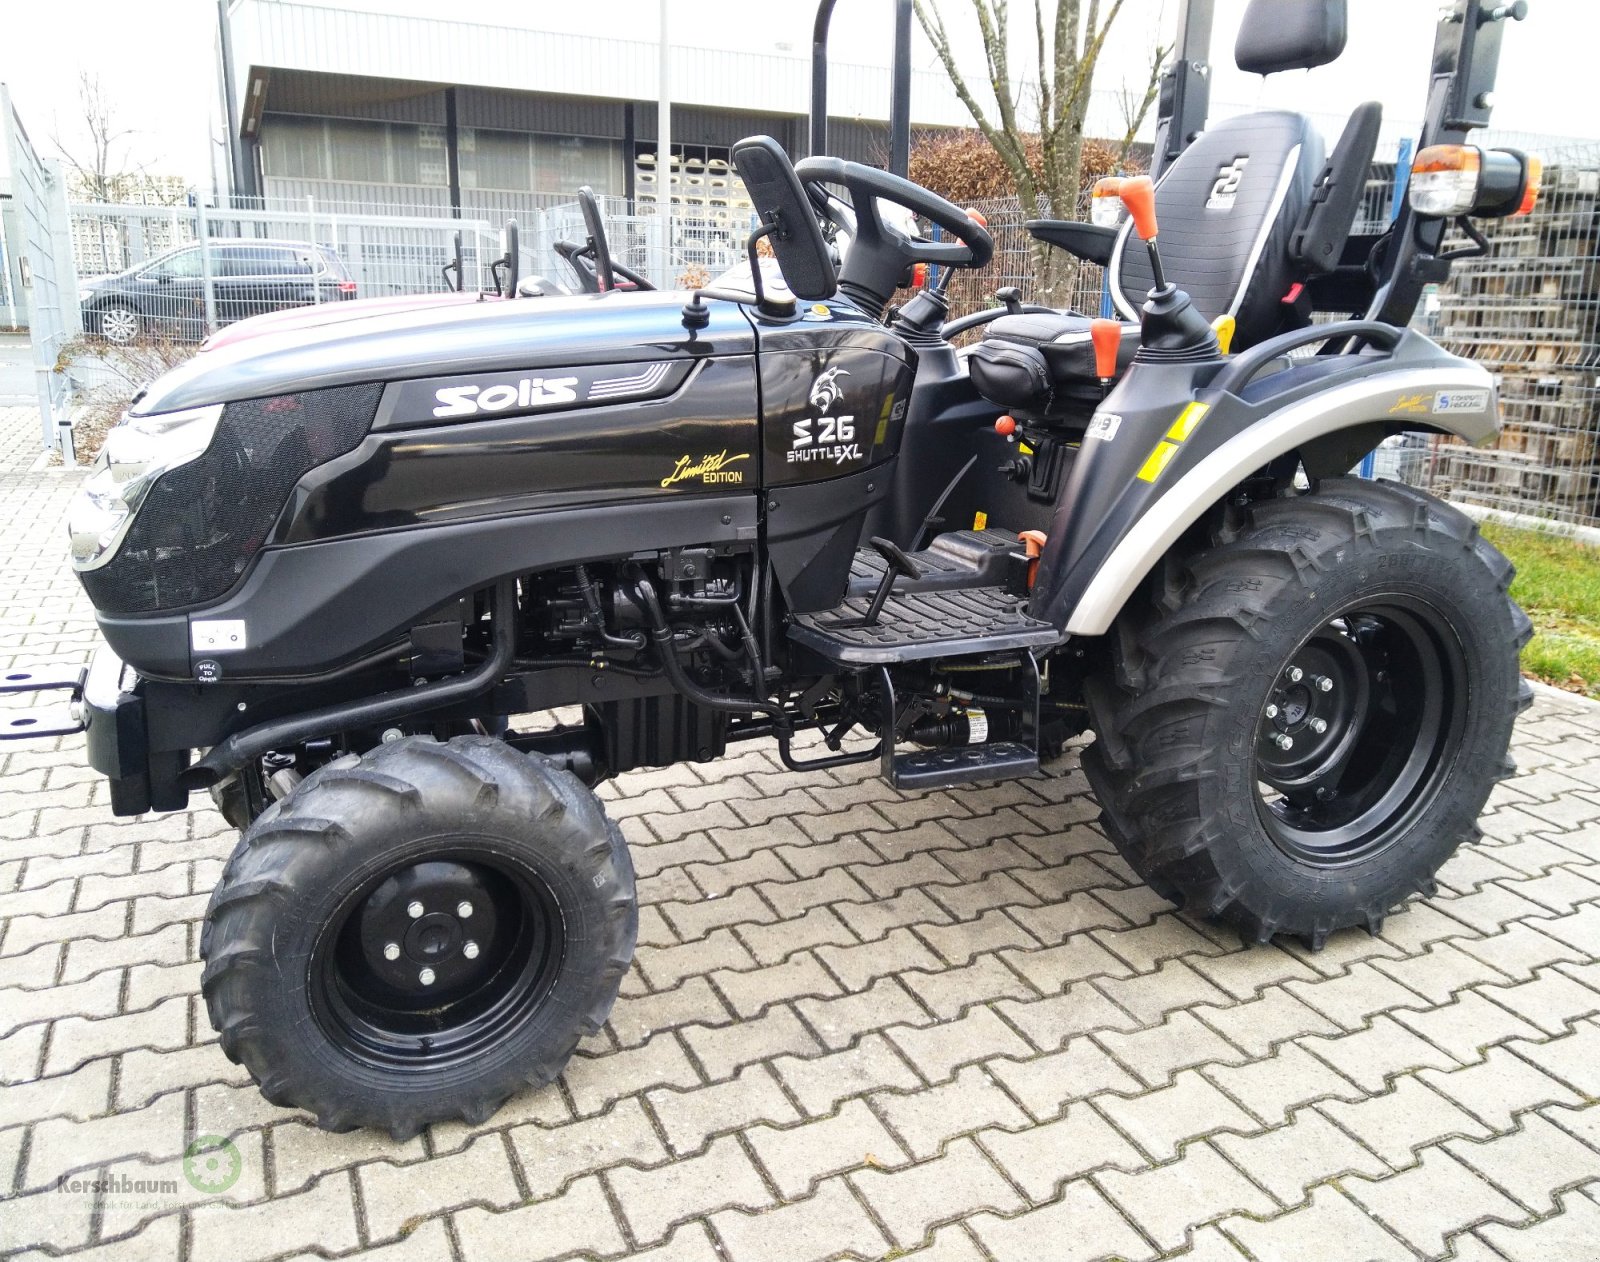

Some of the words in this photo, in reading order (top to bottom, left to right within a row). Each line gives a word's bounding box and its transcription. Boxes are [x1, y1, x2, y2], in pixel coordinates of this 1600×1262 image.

[817, 415, 856, 444] 26
[660, 449, 750, 489] Limited
[703, 471, 743, 484] EDITION
[199, 663, 217, 671] PULL
[198, 675, 218, 683] OPEN
